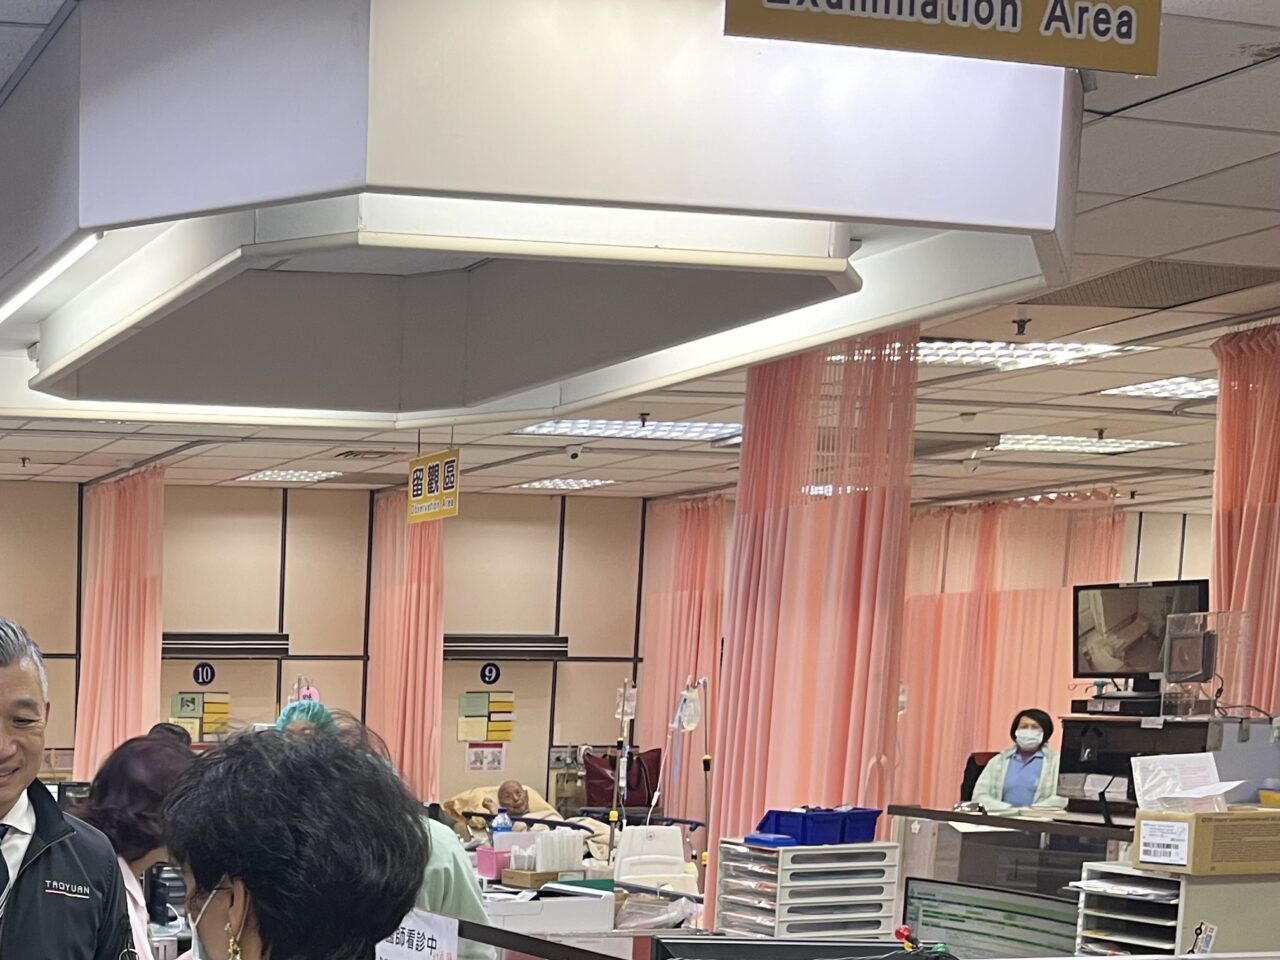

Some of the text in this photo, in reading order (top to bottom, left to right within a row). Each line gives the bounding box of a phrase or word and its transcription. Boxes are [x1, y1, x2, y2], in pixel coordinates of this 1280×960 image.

[763, 0, 1134, 39] nation Area
[197, 666, 212, 683] 10
[484, 665, 497, 682] 9
